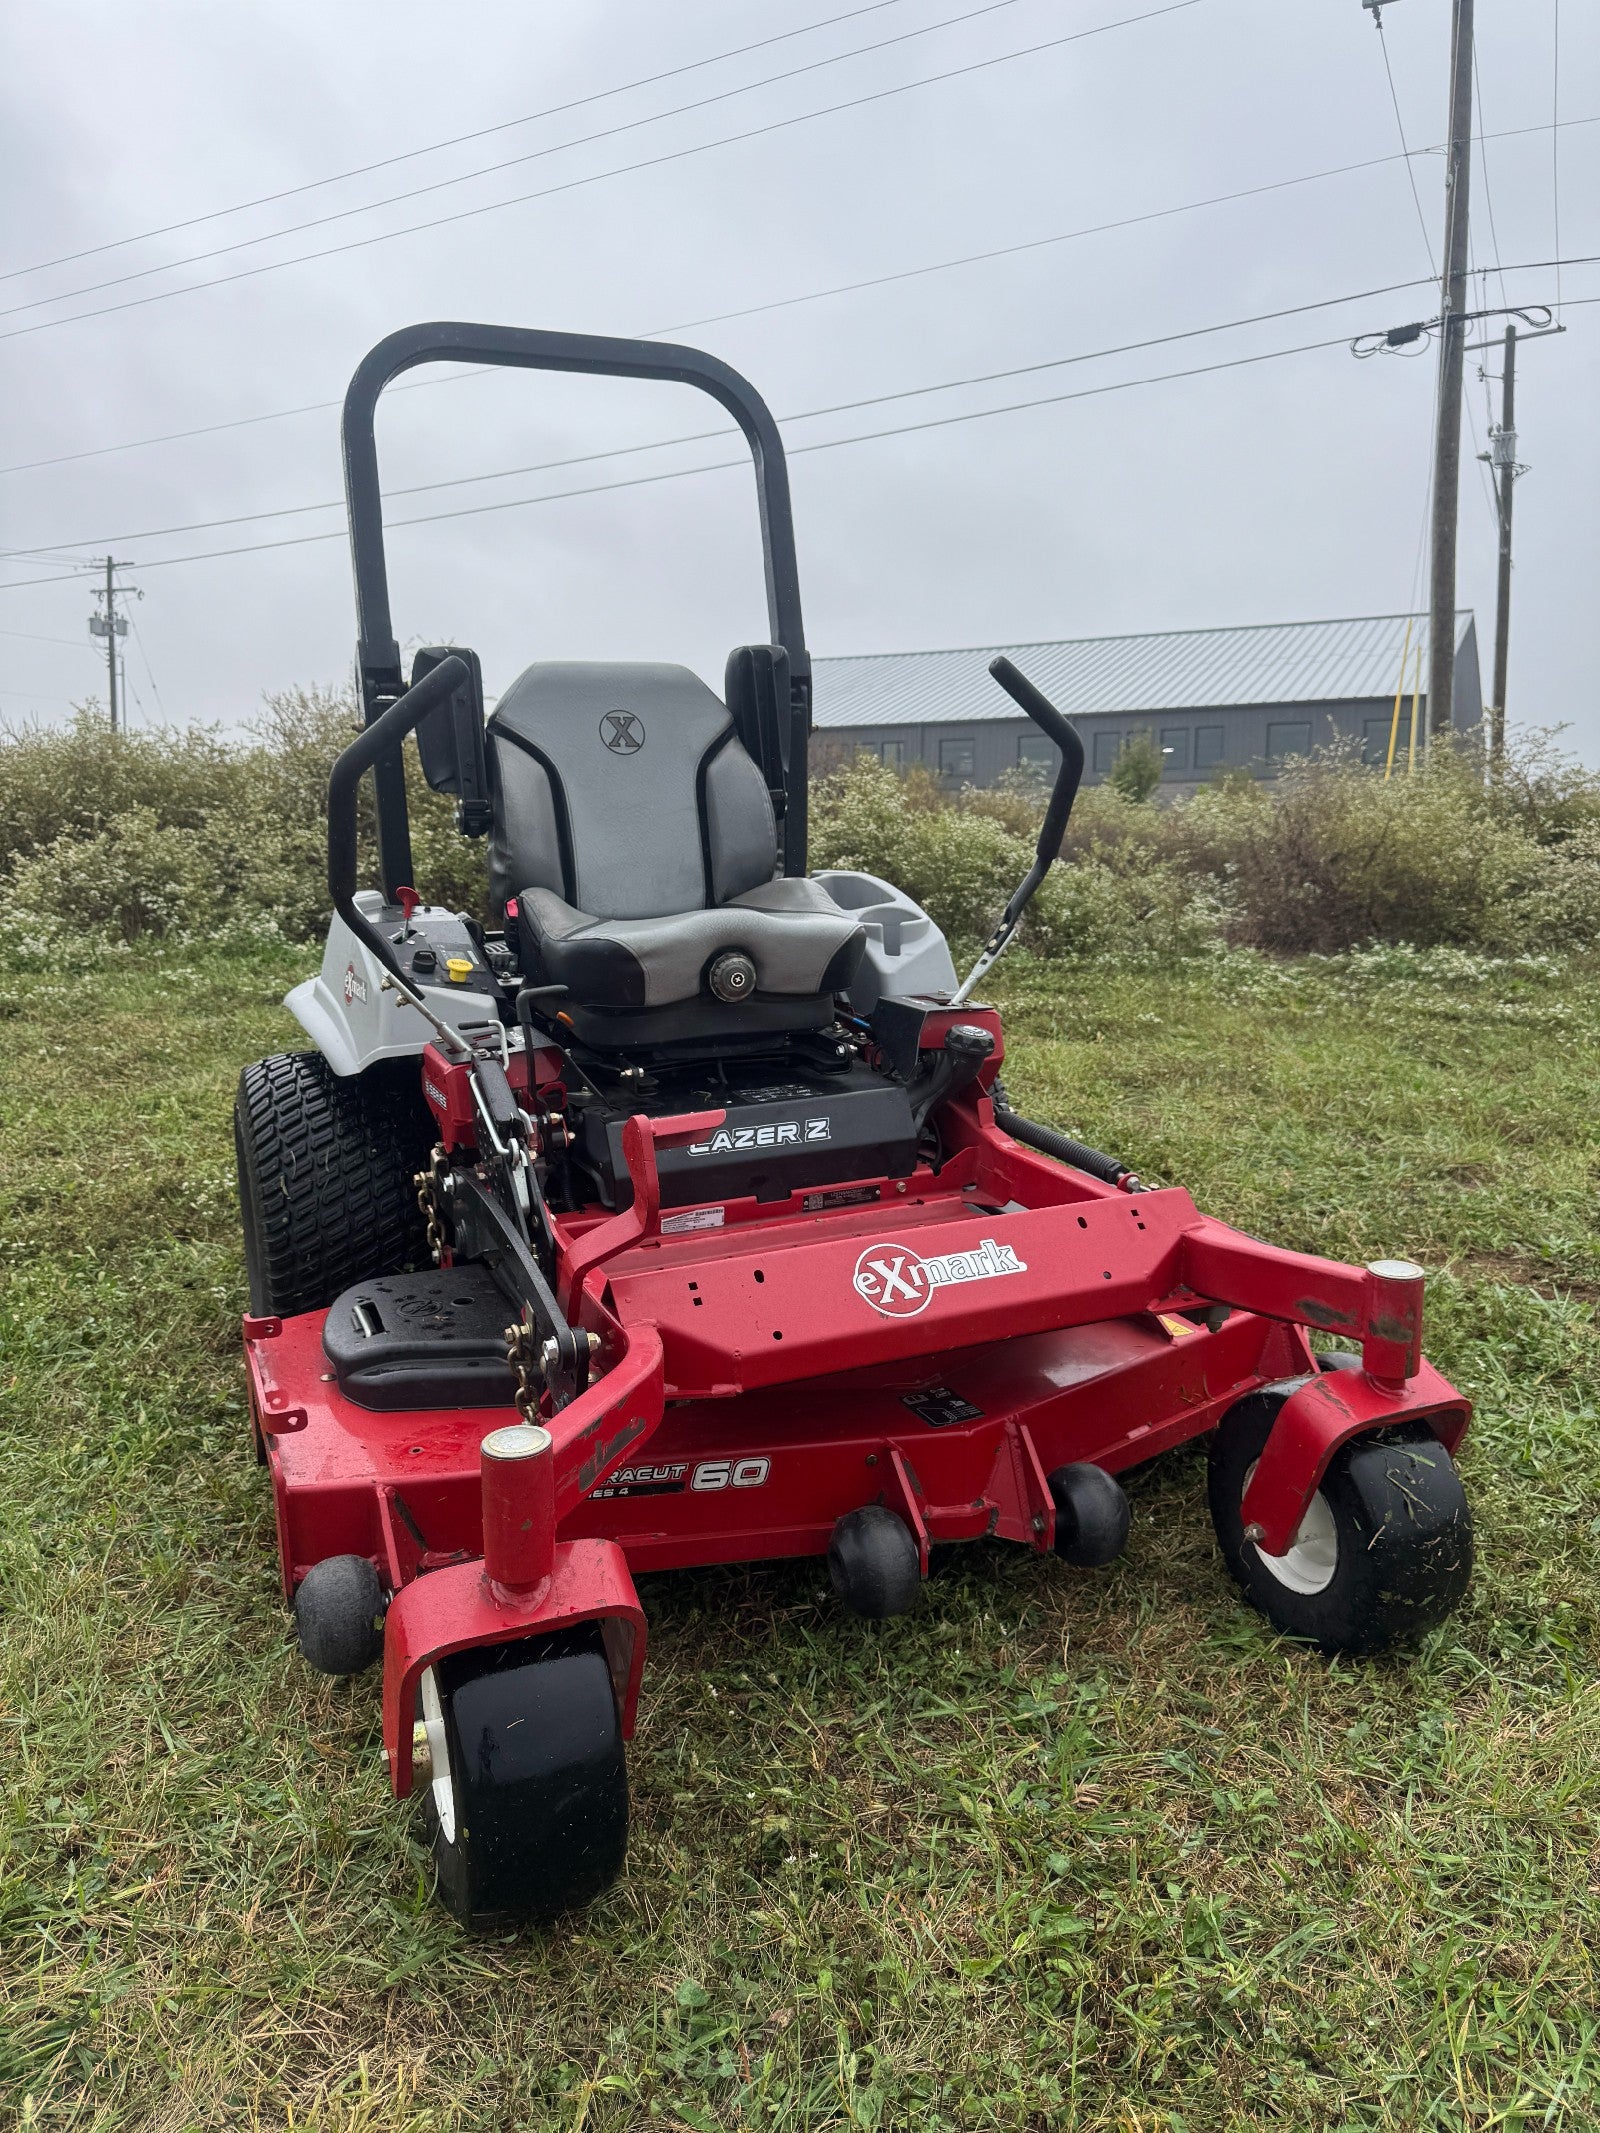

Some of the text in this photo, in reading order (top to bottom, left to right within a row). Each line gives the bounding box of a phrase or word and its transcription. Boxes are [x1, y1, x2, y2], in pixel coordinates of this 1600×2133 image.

[606, 716, 641, 748] X
[345, 970, 367, 1002] eXmark
[805, 1118, 830, 1141] Z
[854, 1241, 1022, 1306] eXmark
[605, 1458, 770, 1491] RACUT 60
[618, 1486, 629, 1496] 4
